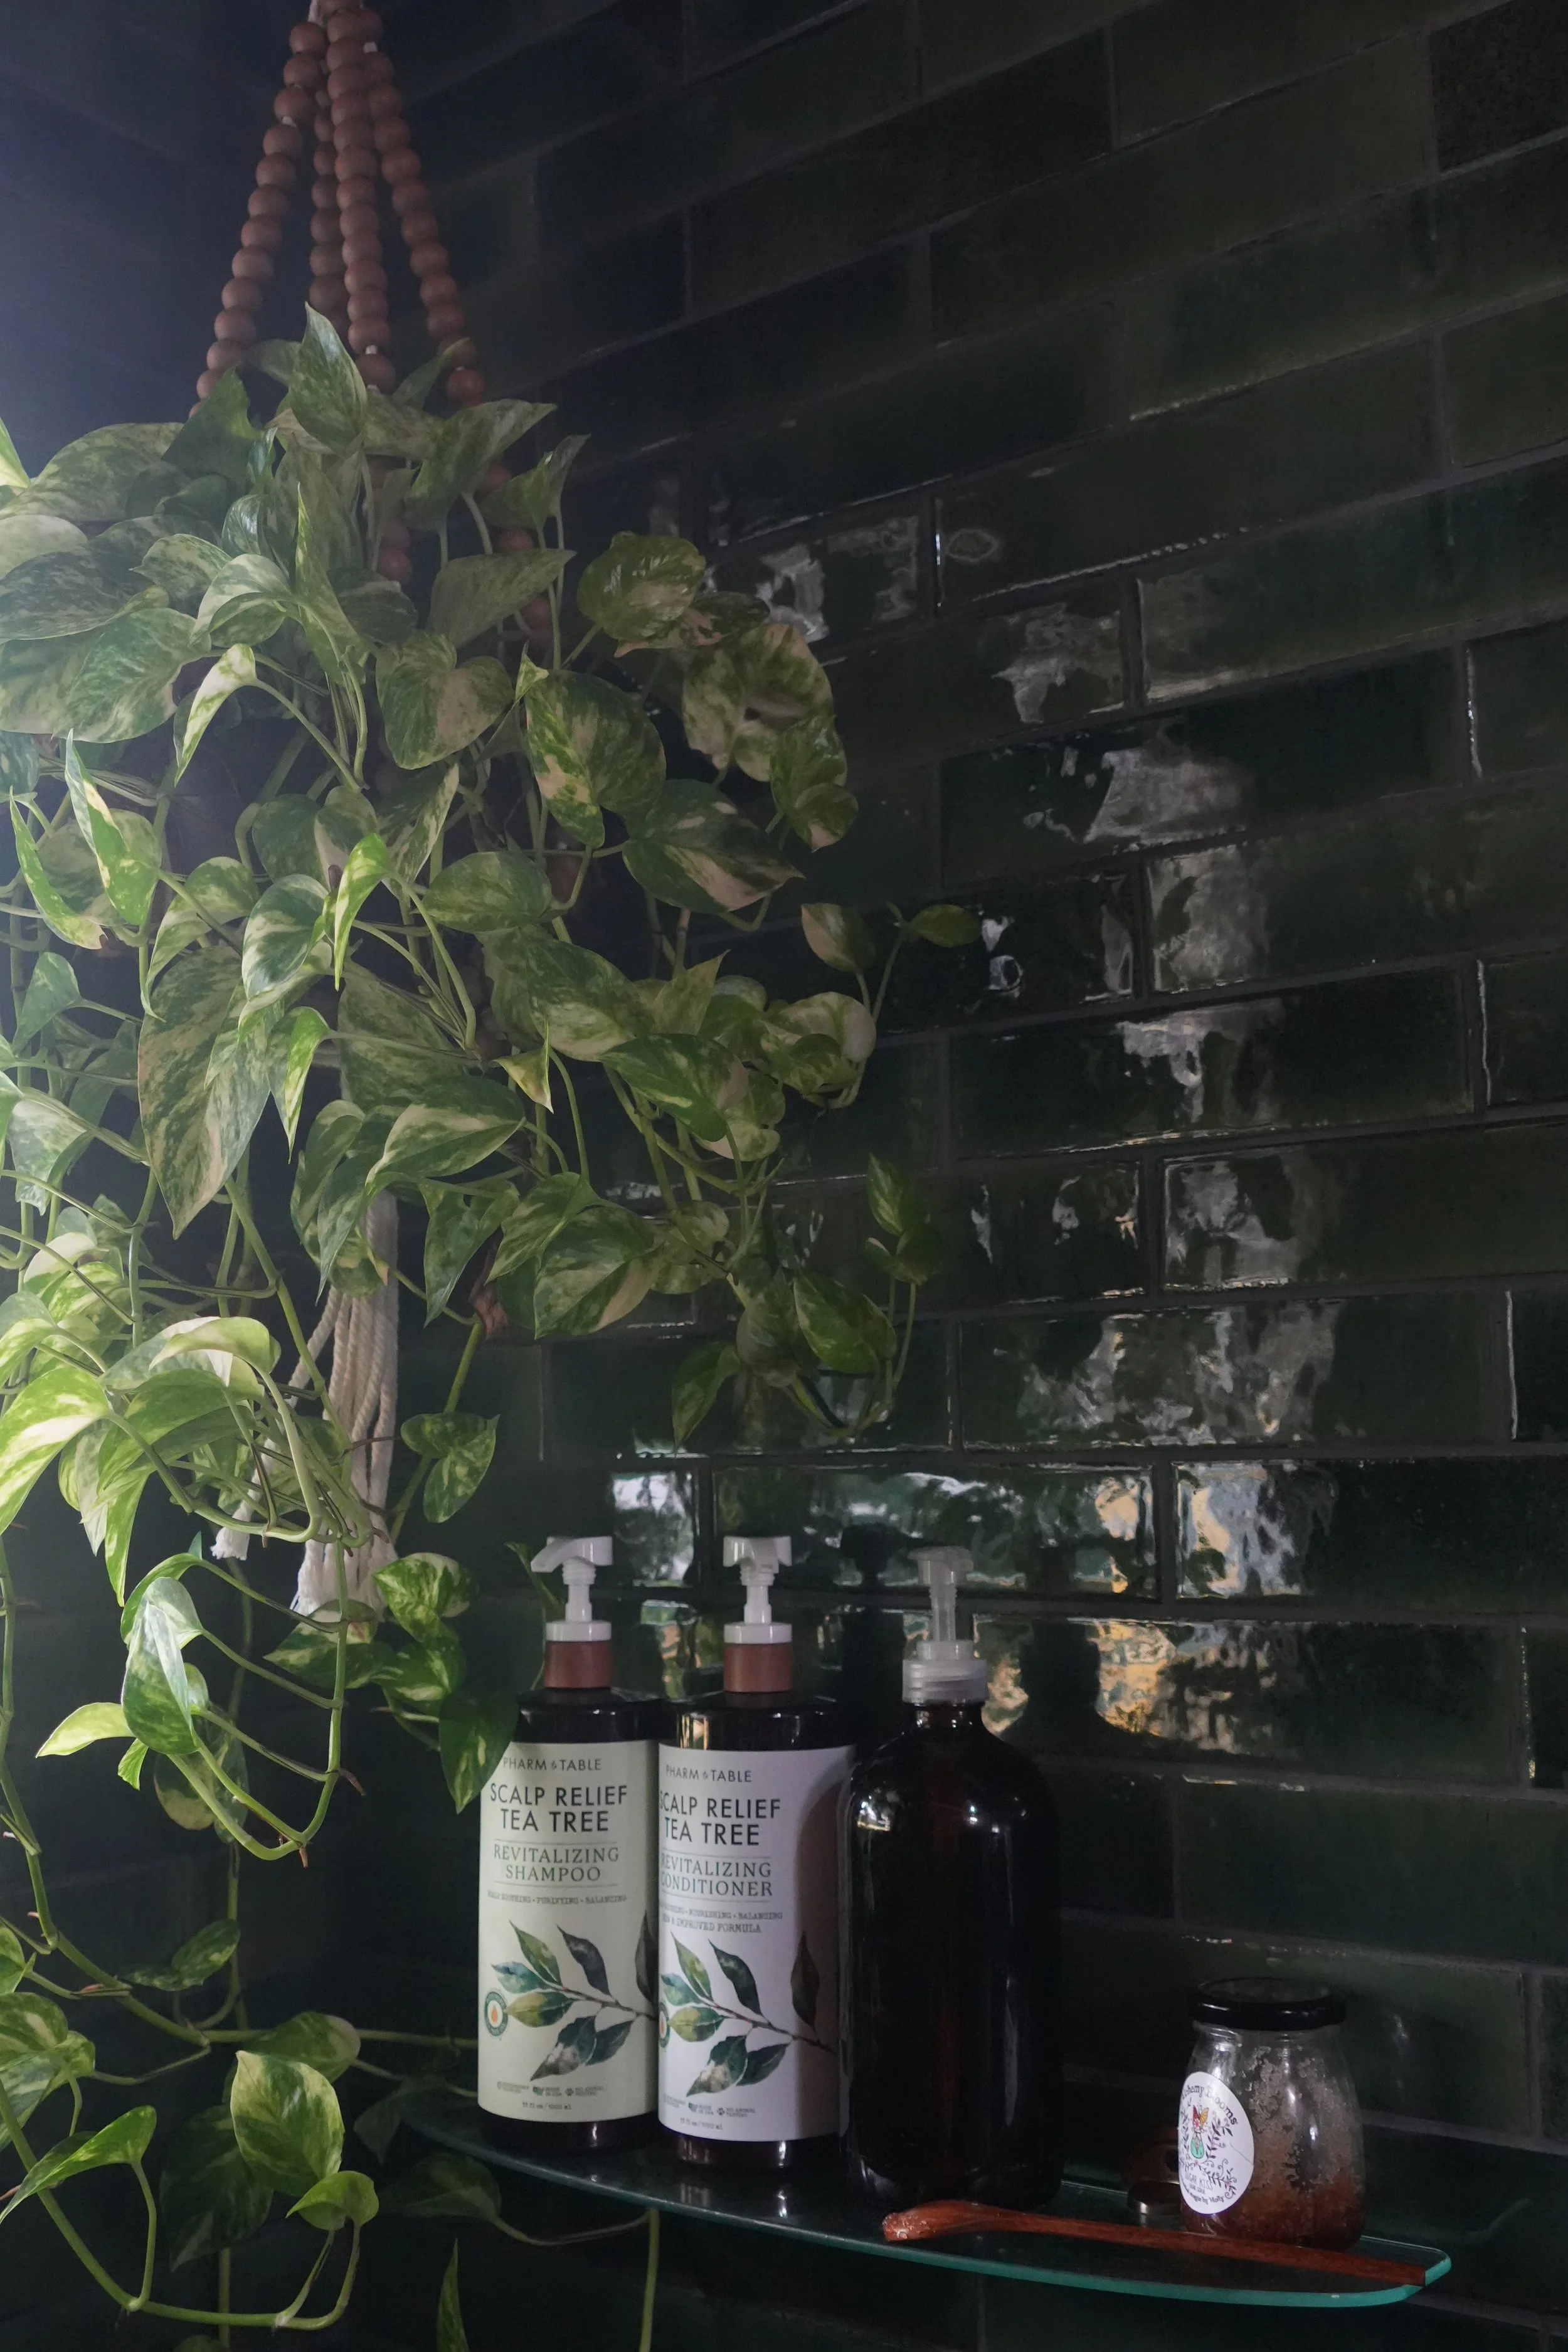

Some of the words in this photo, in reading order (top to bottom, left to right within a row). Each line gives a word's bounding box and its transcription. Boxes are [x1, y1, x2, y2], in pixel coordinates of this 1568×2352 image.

[503, 1757, 546, 1771] PHARM
[559, 1759, 601, 1771] TABLE
[666, 1765, 699, 1779] PHARM
[711, 1769, 751, 1783] TABLE
[490, 1783, 545, 1806] SCALP
[556, 1786, 627, 1806] RELIEF
[707, 1798, 780, 1819] RELIEF
[501, 1808, 539, 1831] TEA
[549, 1811, 609, 1833] TREE
[665, 1816, 692, 1842] TEA
[701, 1823, 760, 1845] TREE
[494, 1844, 619, 1864] REVITALIZING
[506, 1865, 601, 1882] SHAMPOO
[660, 1853, 771, 1878] REVITALIZING
[661, 1871, 773, 1897] CONDITIONER
[537, 1896, 578, 1904] PURIFYING
[585, 1893, 627, 1904] BALANCING
[738, 1912, 783, 1920] BALANCING
[718, 1923, 761, 1934] FORMULA
